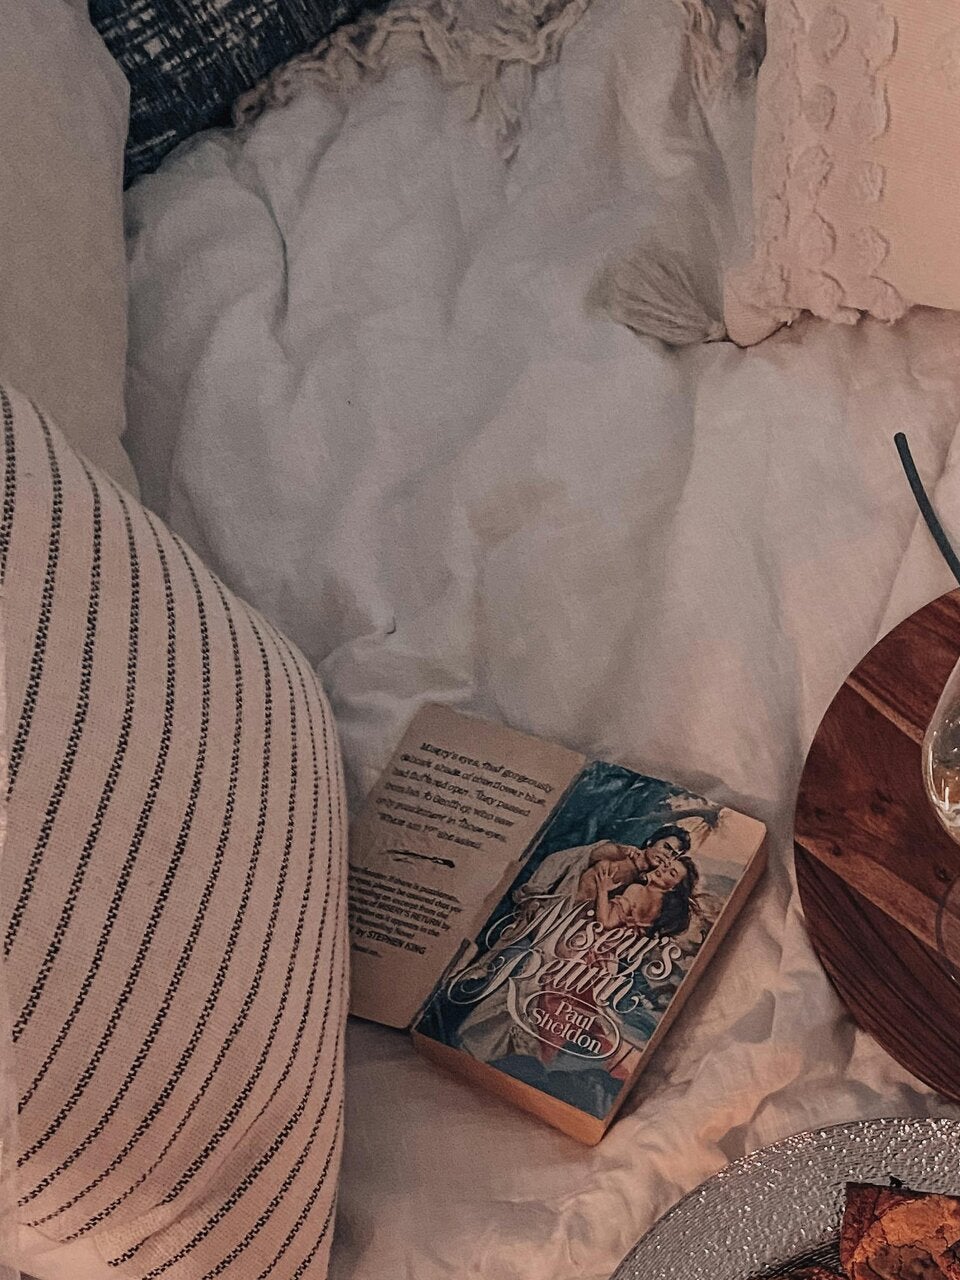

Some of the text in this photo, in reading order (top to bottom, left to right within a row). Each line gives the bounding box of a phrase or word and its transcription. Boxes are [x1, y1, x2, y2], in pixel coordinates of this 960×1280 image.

[411, 914, 442, 926] RETURN
[486, 894, 682, 981] Misery's
[367, 931, 404, 947] STEPHEN
[405, 943, 426, 953] KING
[448, 949, 643, 1020] Return
[530, 1007, 602, 1055] Sheldon
[556, 1001, 597, 1030] Paul
